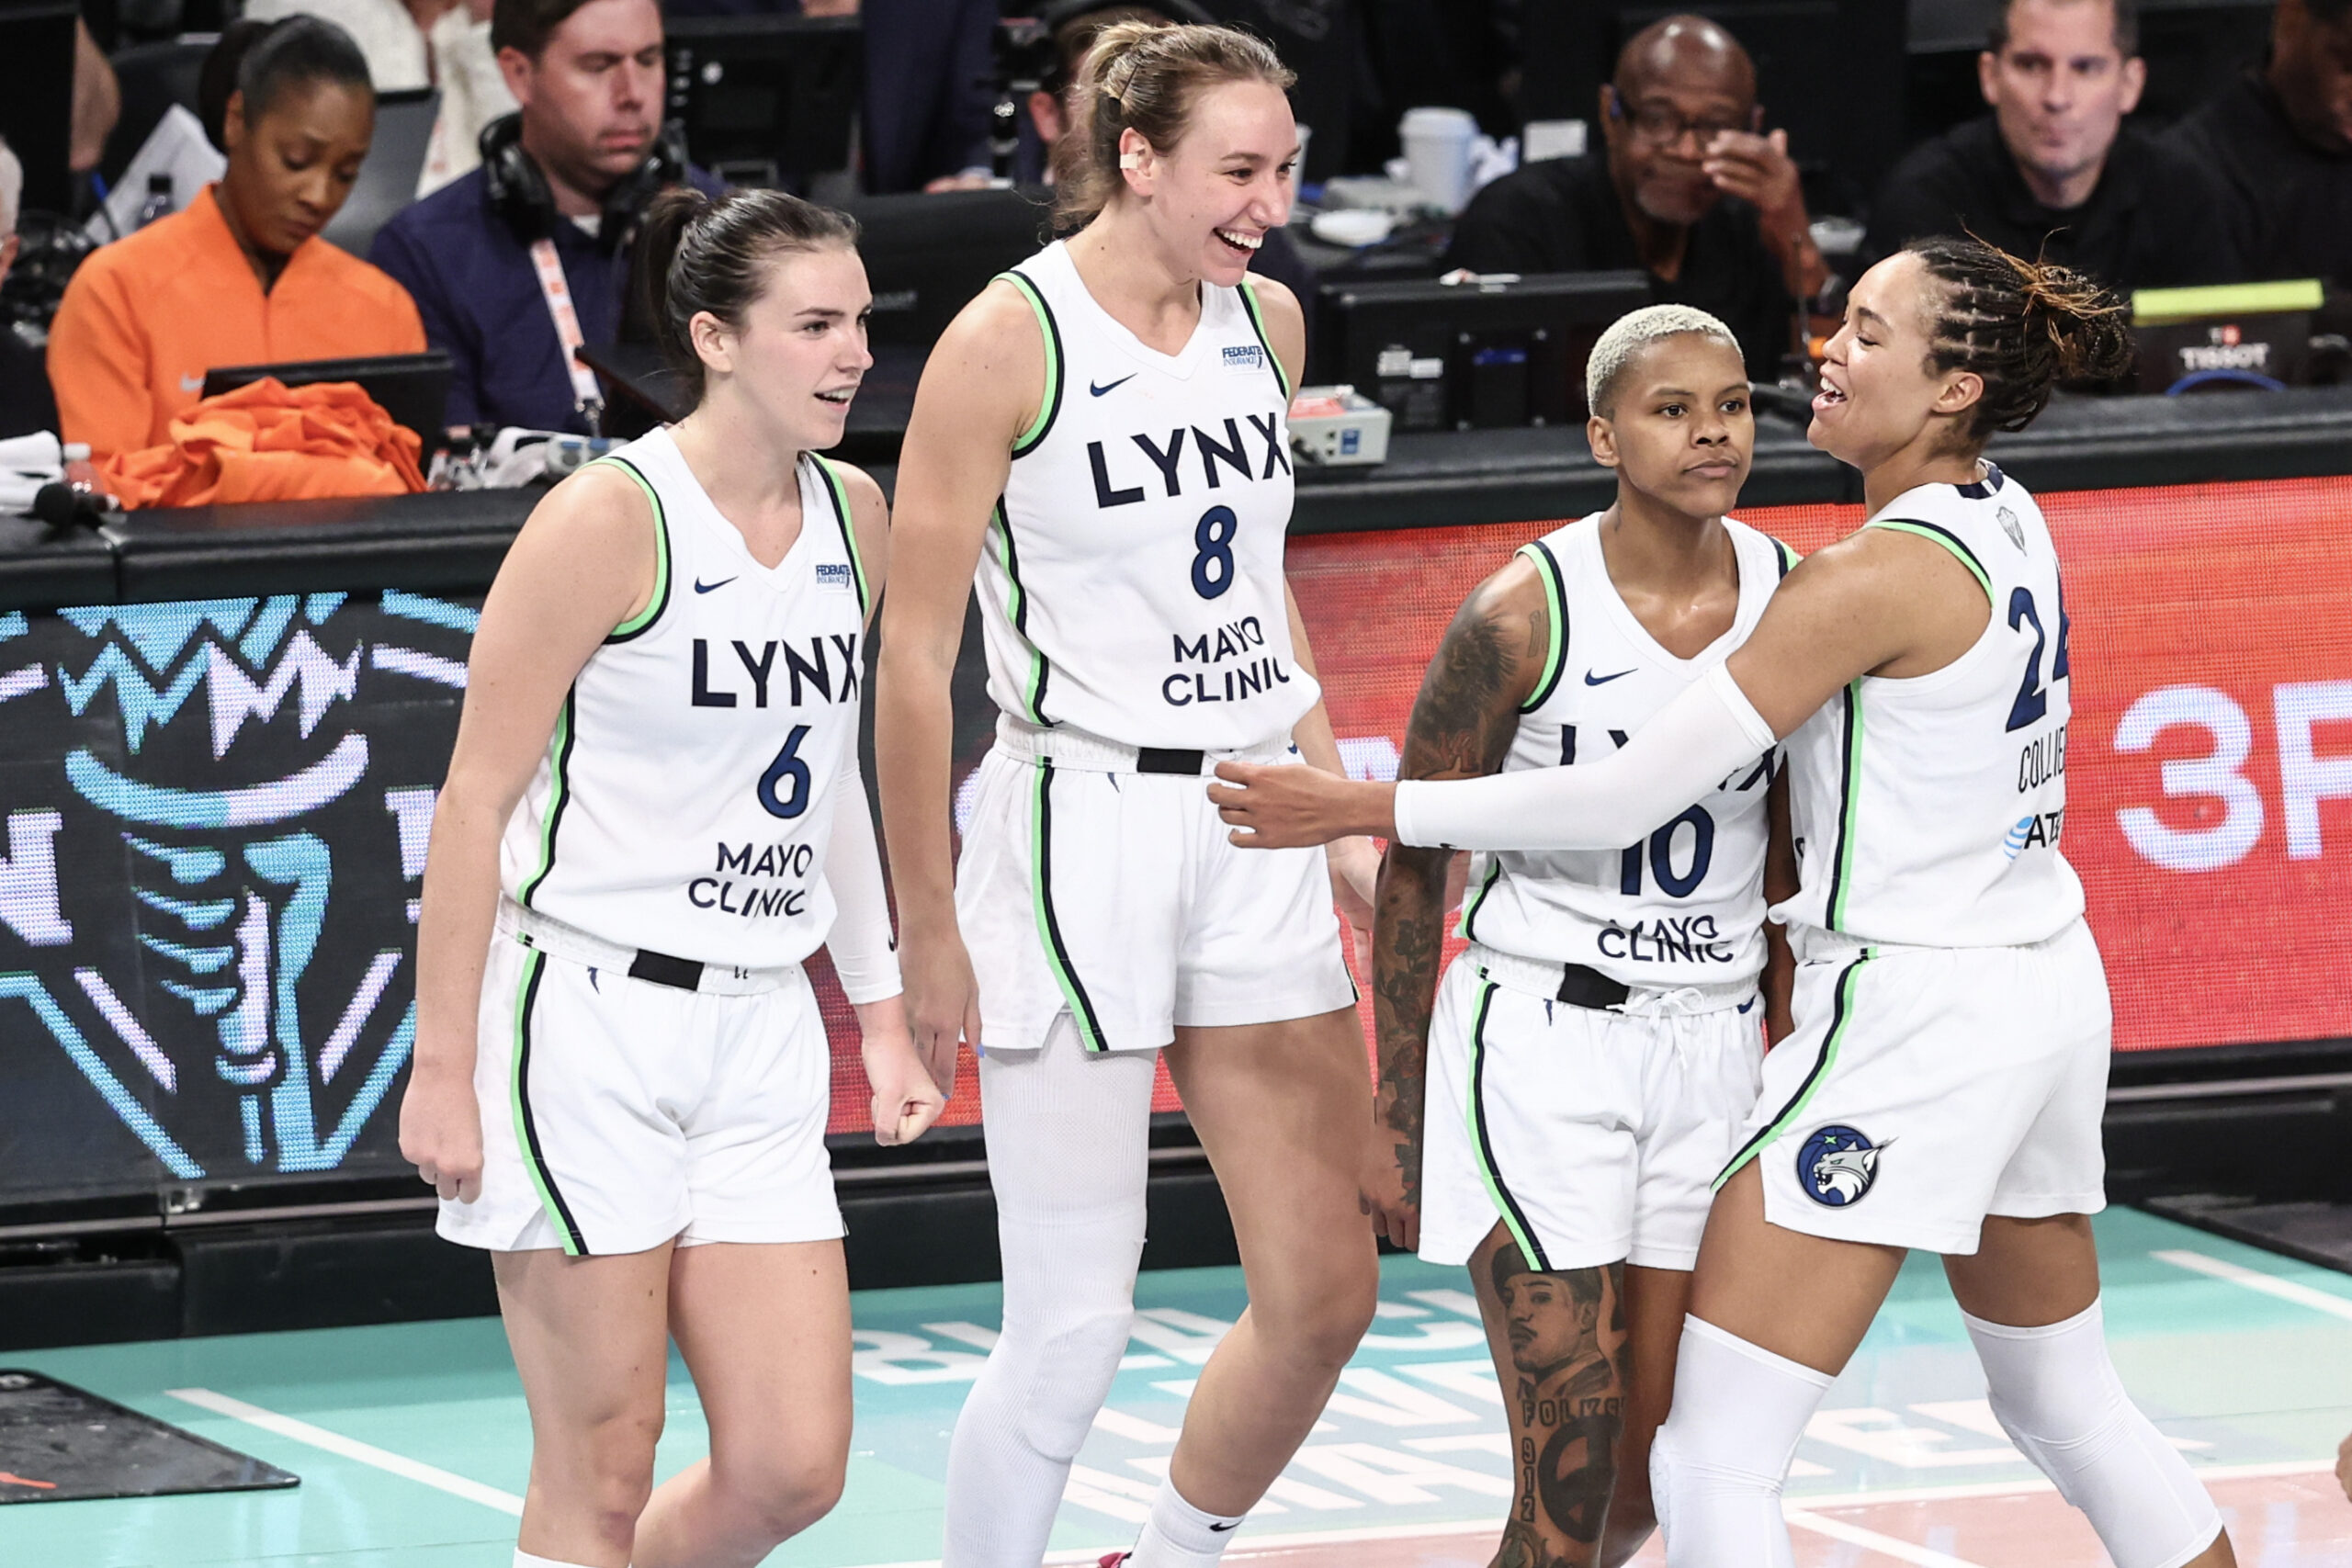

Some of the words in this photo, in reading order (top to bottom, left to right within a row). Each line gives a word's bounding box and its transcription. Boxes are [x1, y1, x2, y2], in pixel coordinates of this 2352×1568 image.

[1087, 412, 1291, 509] LYNX
[1191, 505, 1238, 600] 8
[692, 633, 857, 708] LYNX
[1173, 616, 1264, 663] MAYO
[757, 725, 811, 819] 6
[2018, 726, 2067, 794] COLLIE
[716, 842, 813, 878] MAYO
[1621, 803, 1714, 898] 10
[688, 877, 806, 918] CLINIC
[1608, 915, 1719, 946] AYO
